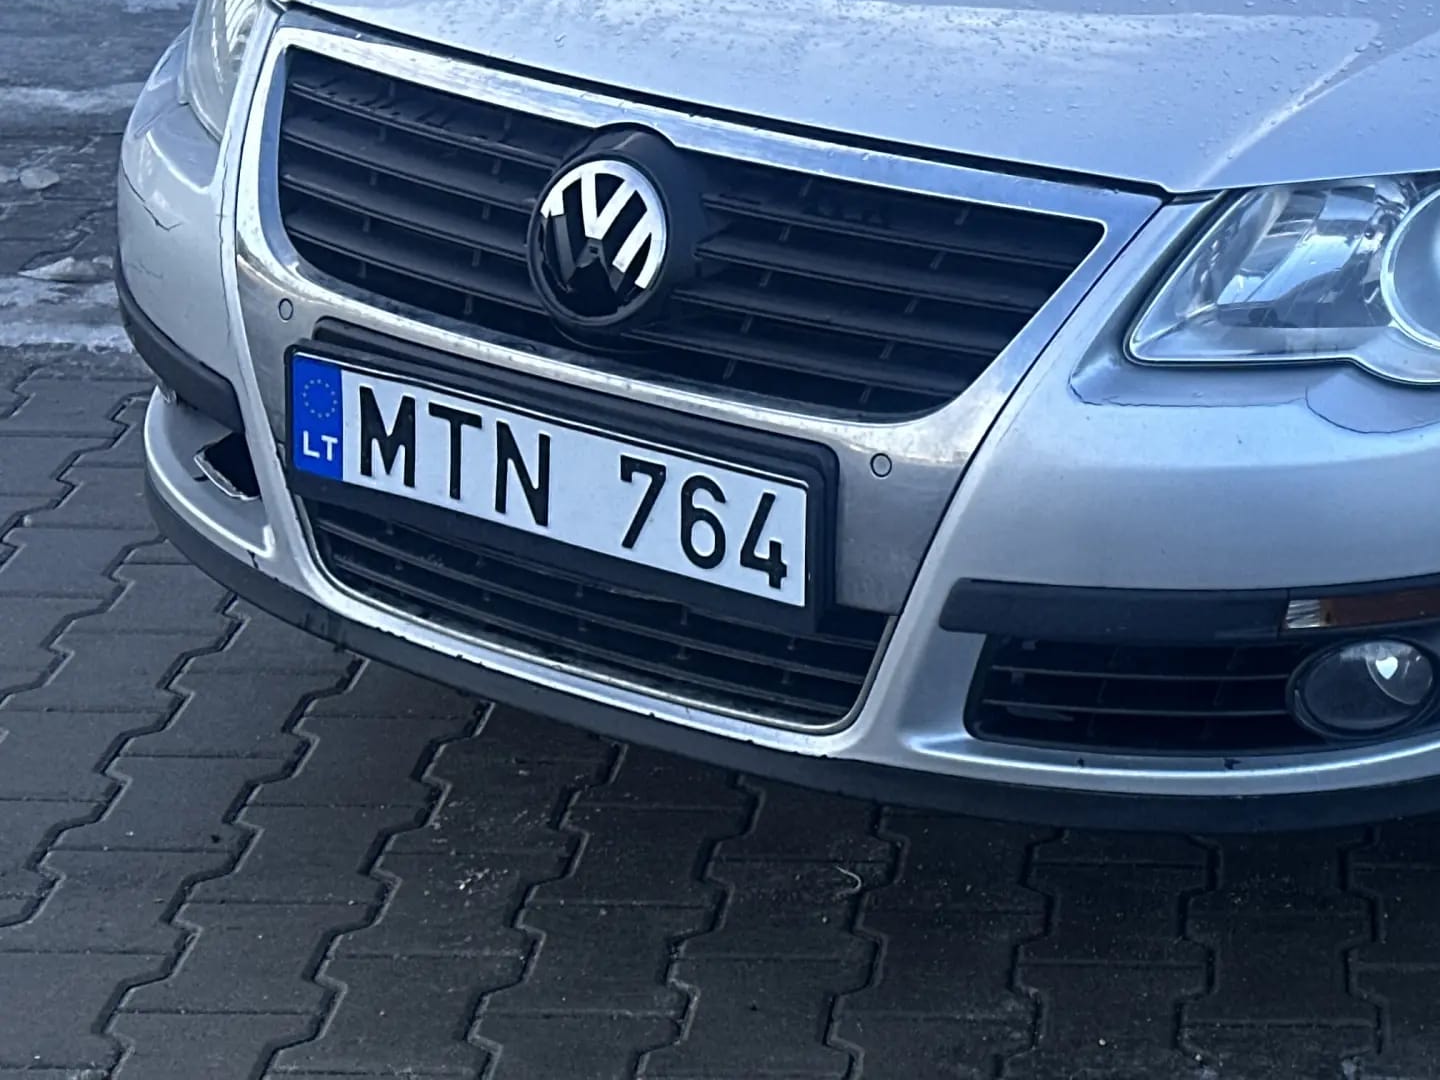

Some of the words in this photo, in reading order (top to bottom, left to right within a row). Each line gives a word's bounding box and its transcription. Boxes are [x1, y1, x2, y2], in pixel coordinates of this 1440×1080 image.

[303, 430, 338, 461] LT
[359, 385, 550, 526] MTN
[620, 455, 788, 590] 764
